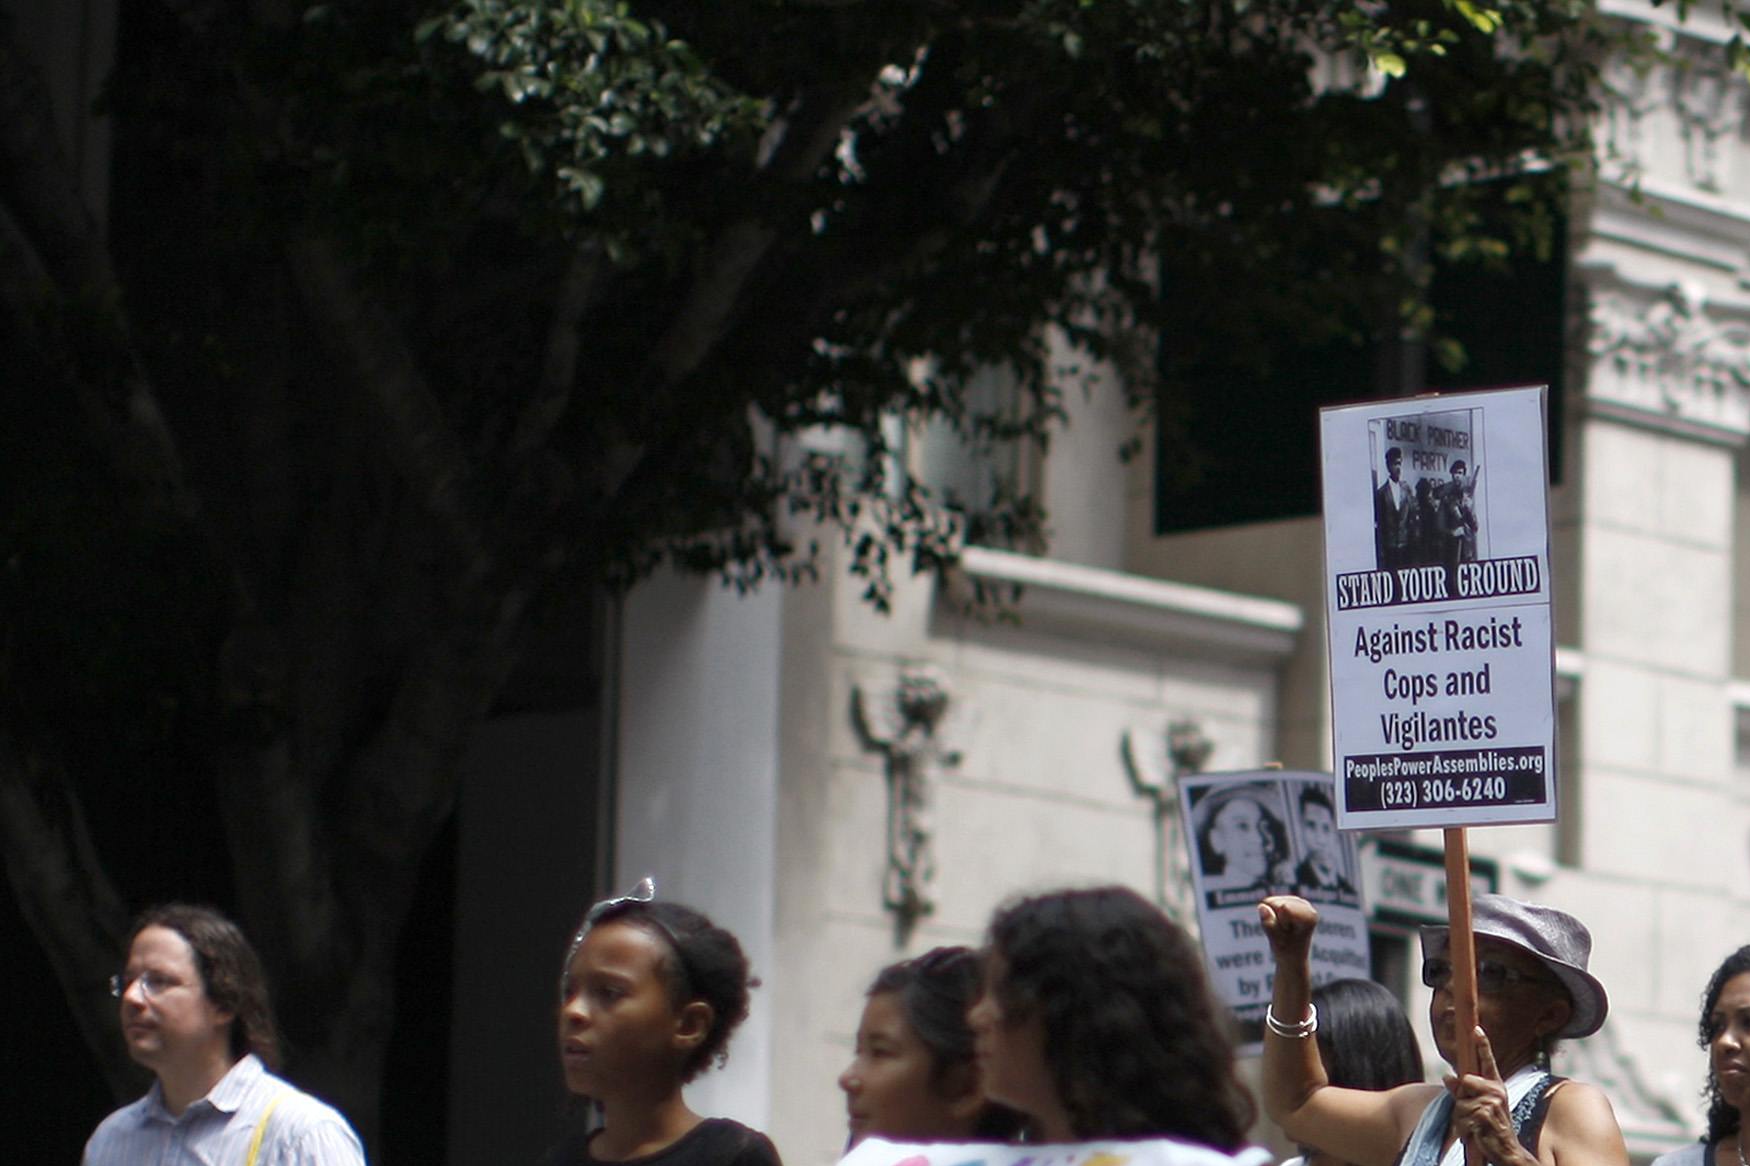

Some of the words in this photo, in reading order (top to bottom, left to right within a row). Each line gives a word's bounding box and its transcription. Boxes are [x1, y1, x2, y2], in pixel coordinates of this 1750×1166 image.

[1413, 450, 1448, 471] PARTY
[1337, 573, 1393, 609] STAND
[1397, 566, 1448, 602] YOUR
[1457, 556, 1539, 595] GROUND
[1354, 621, 1438, 662] Against
[1444, 616, 1522, 651] Racist
[1383, 668, 1438, 705] Cops
[1445, 663, 1490, 694] and
[1380, 711, 1498, 751] Vigilantes
[1346, 753, 1544, 783] PeoplesPowerAssemblies.org
[1380, 781, 1418, 807] (323)
[1422, 777, 1506, 803] 306-6240
